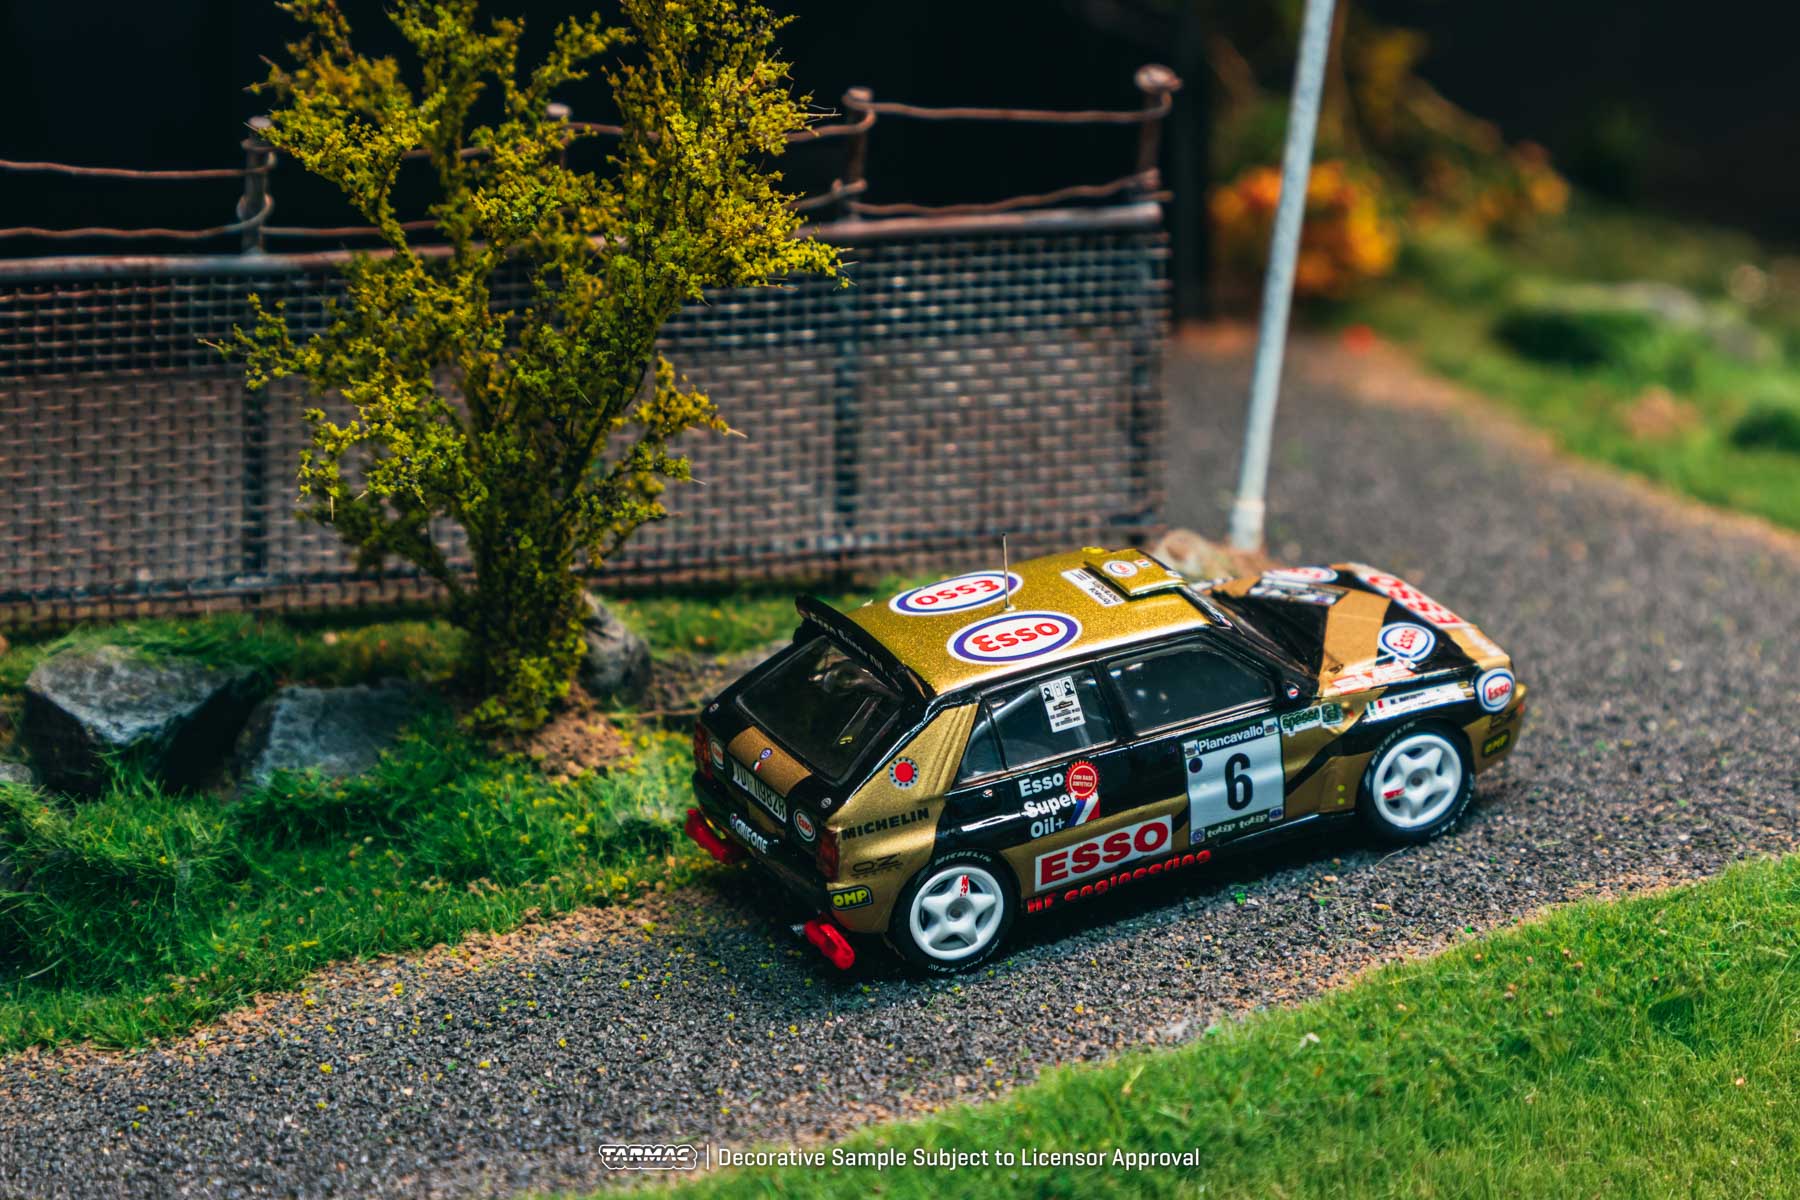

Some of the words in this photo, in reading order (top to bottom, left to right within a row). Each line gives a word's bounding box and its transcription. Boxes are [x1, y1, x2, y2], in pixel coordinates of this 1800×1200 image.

[1198, 724, 1264, 752] Piancavallo
[1018, 772, 1064, 798] Esso
[1224, 752, 1253, 811] 6
[1023, 791, 1077, 818] Super
[841, 808, 929, 840] MICHELIN
[1030, 816, 1065, 839] Oil+
[1041, 822, 1169, 886] ESSO
[832, 889, 868, 907] OMP
